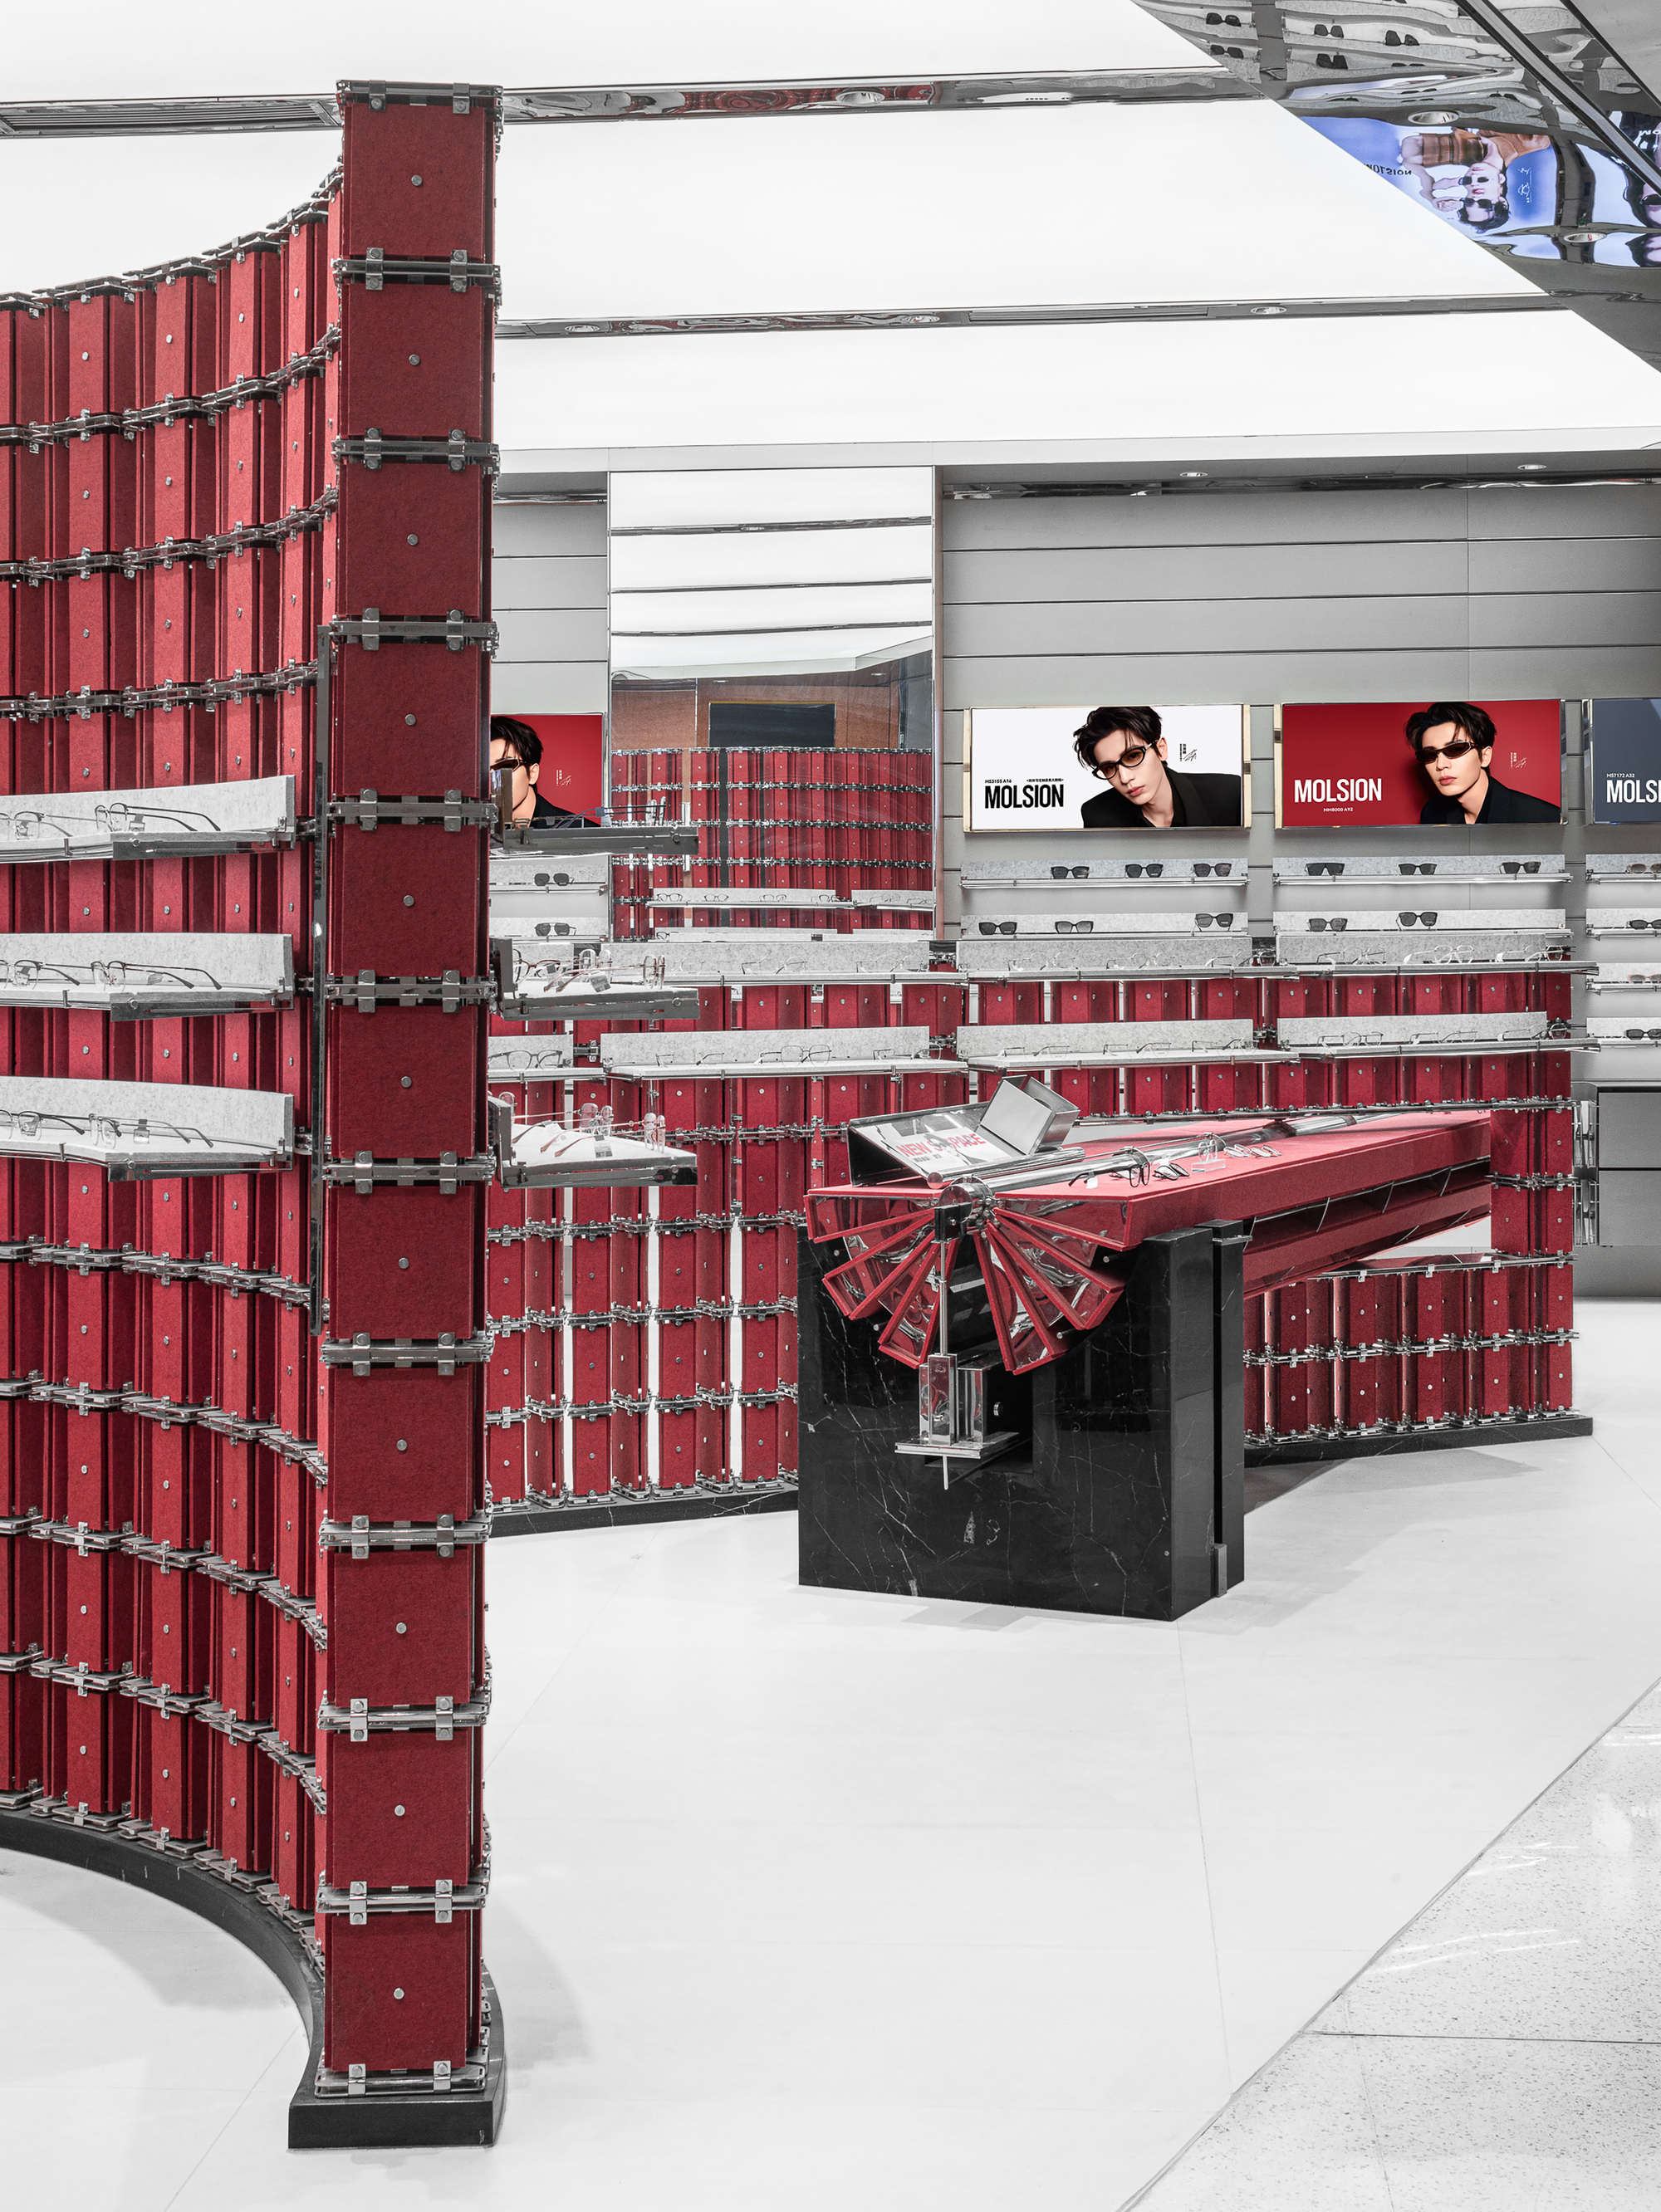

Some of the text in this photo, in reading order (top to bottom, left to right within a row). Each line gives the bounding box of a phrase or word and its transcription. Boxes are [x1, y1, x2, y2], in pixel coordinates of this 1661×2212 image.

[985, 784, 1064, 809] MOLSION
[1294, 778, 1382, 803] MOLSION
[896, 1142, 932, 1157] NEW
